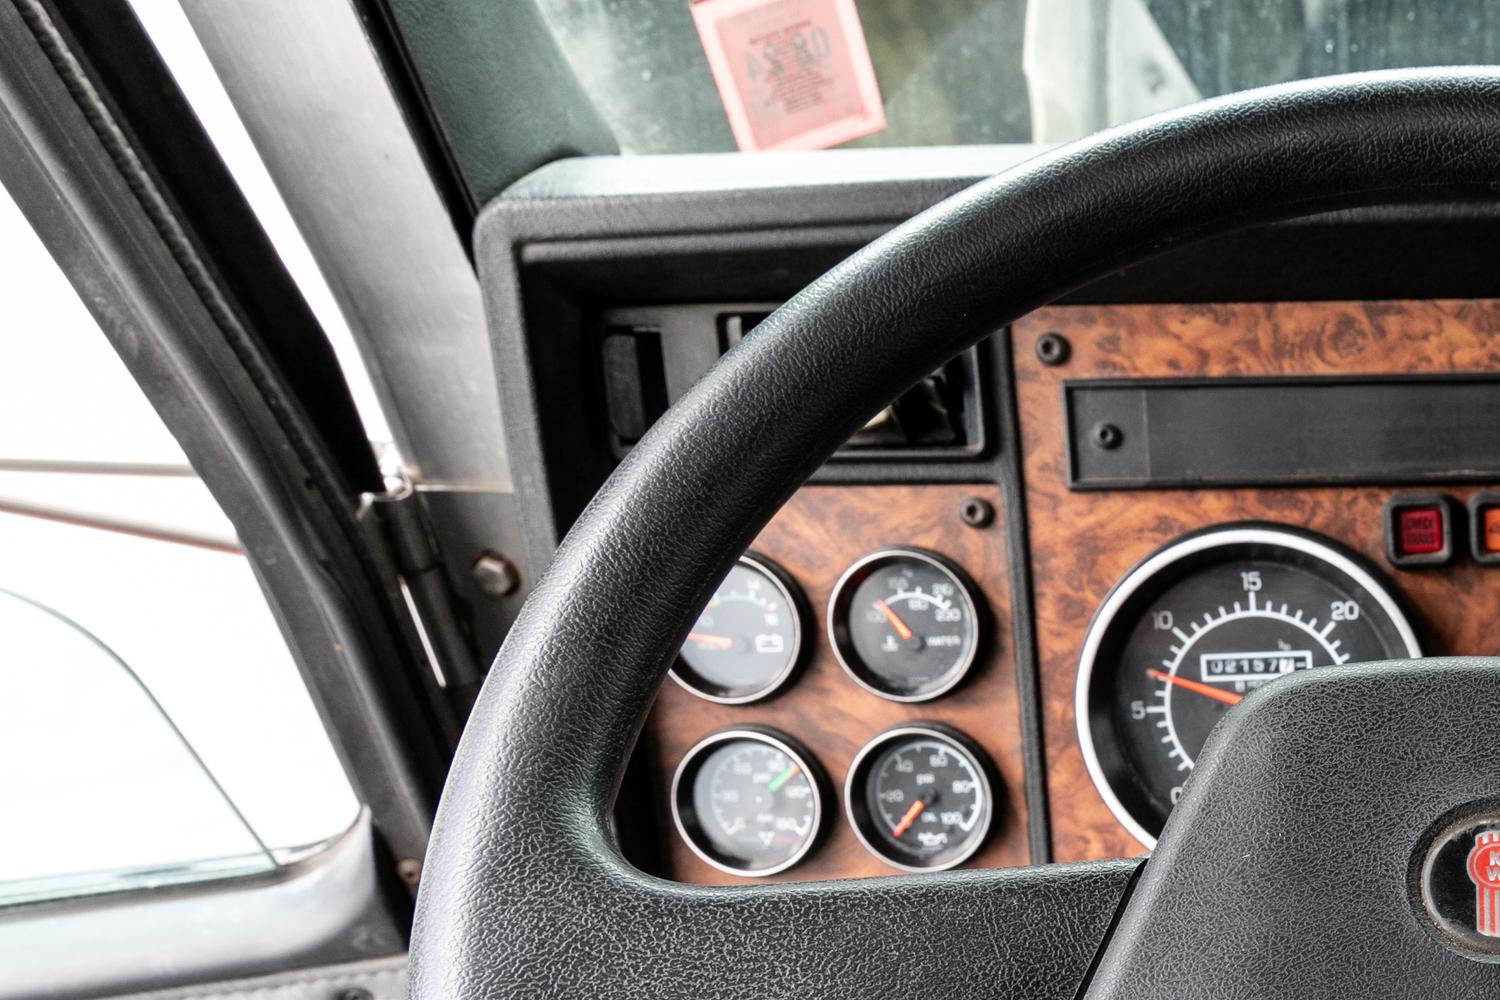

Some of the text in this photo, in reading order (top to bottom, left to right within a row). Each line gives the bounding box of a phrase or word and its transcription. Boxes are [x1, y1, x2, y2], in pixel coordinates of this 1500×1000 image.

[1241, 571, 1262, 592] 15
[1154, 611, 1174, 631] 10
[1331, 601, 1360, 621] 20
[1131, 701, 1147, 720] 5
